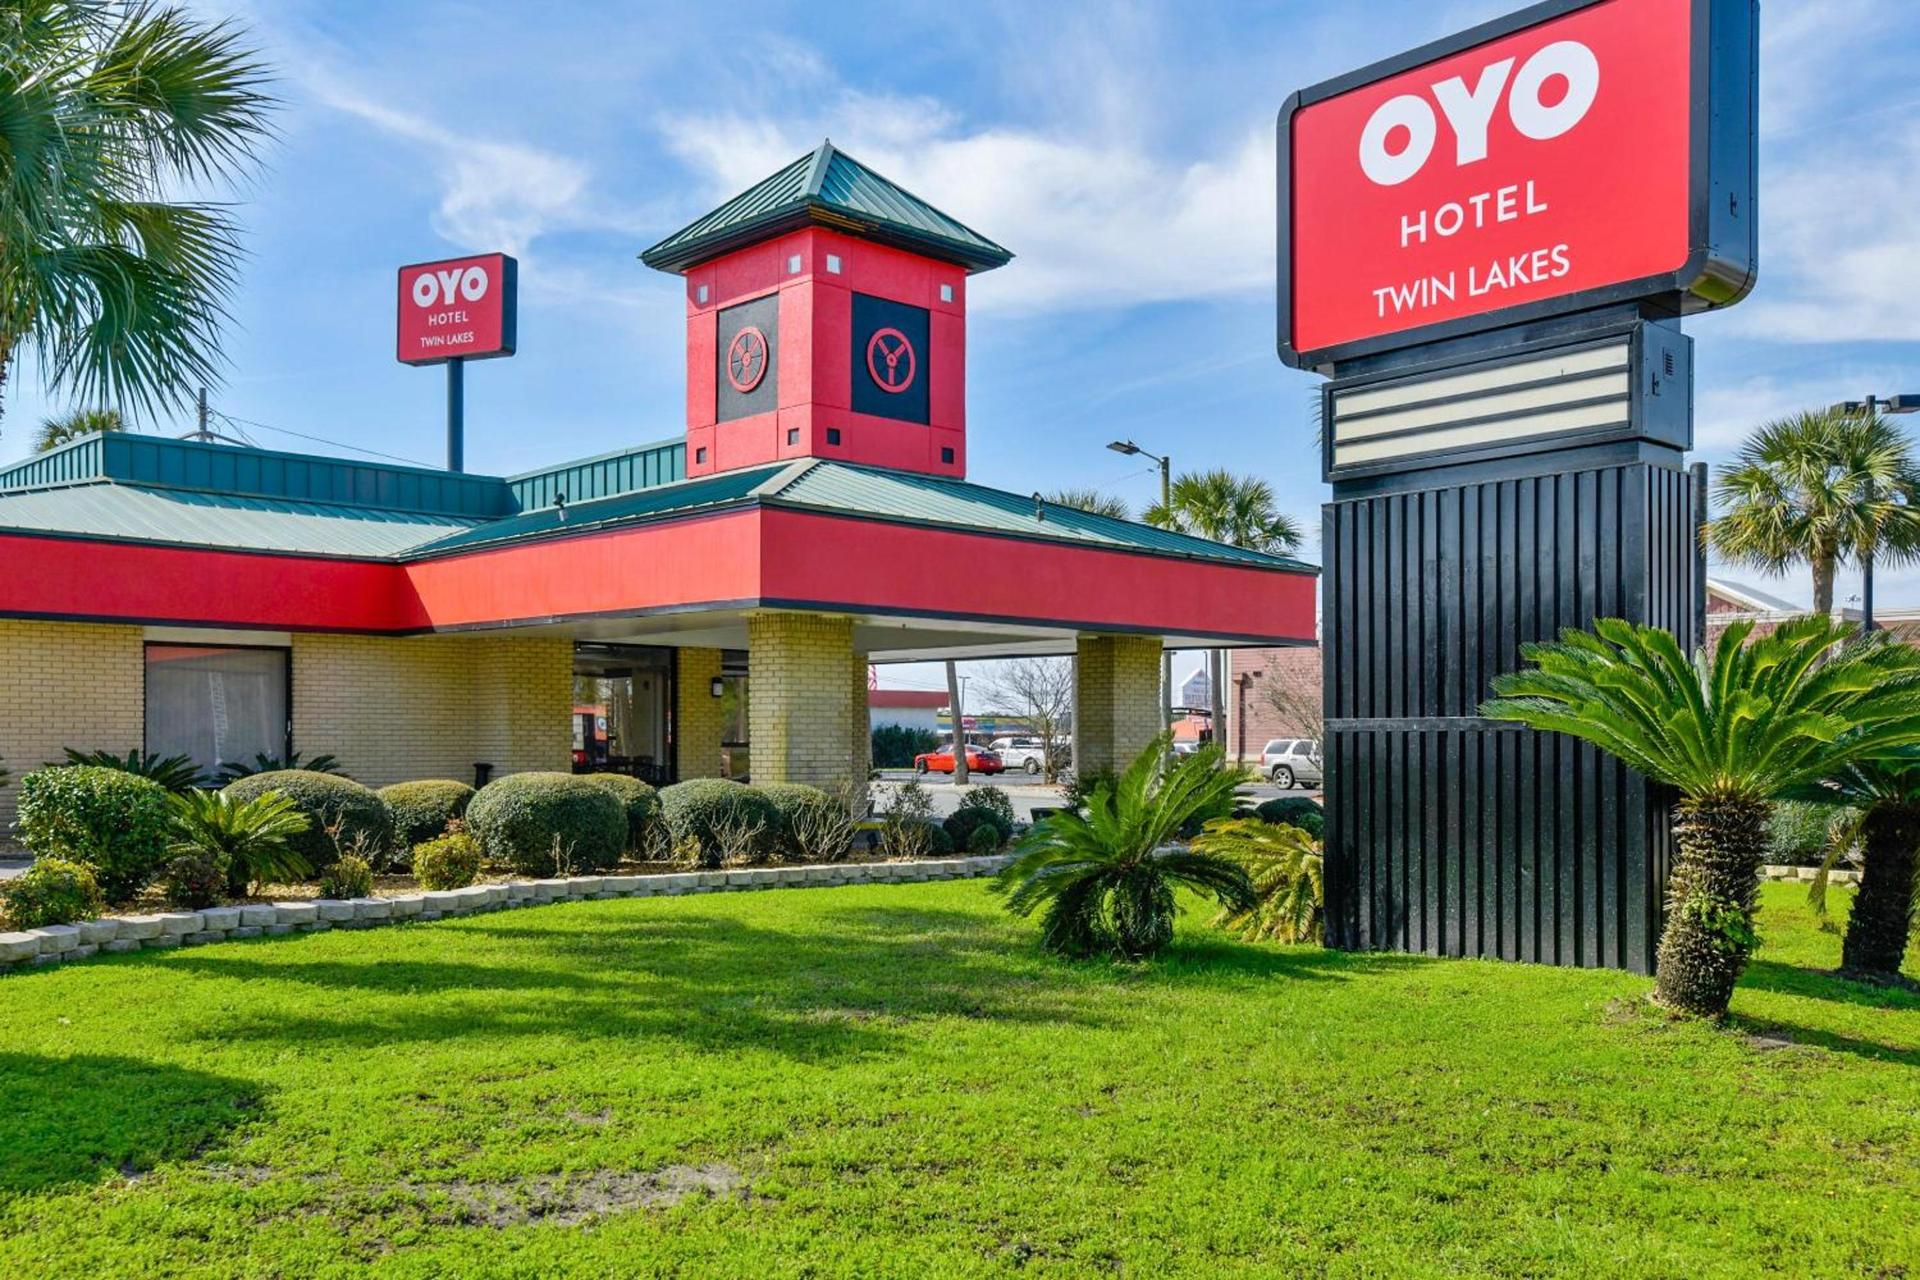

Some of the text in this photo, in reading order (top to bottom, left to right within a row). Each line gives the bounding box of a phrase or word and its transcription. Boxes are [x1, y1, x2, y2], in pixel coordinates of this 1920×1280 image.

[1359, 40, 1600, 186] OYO
[1401, 180, 1548, 247] HOTEL
[413, 266, 488, 307] OYO
[1373, 244, 1570, 318] TWIN LAKES
[420, 332, 474, 348] TWIN LAKES
[428, 311, 468, 326] HOTEL
